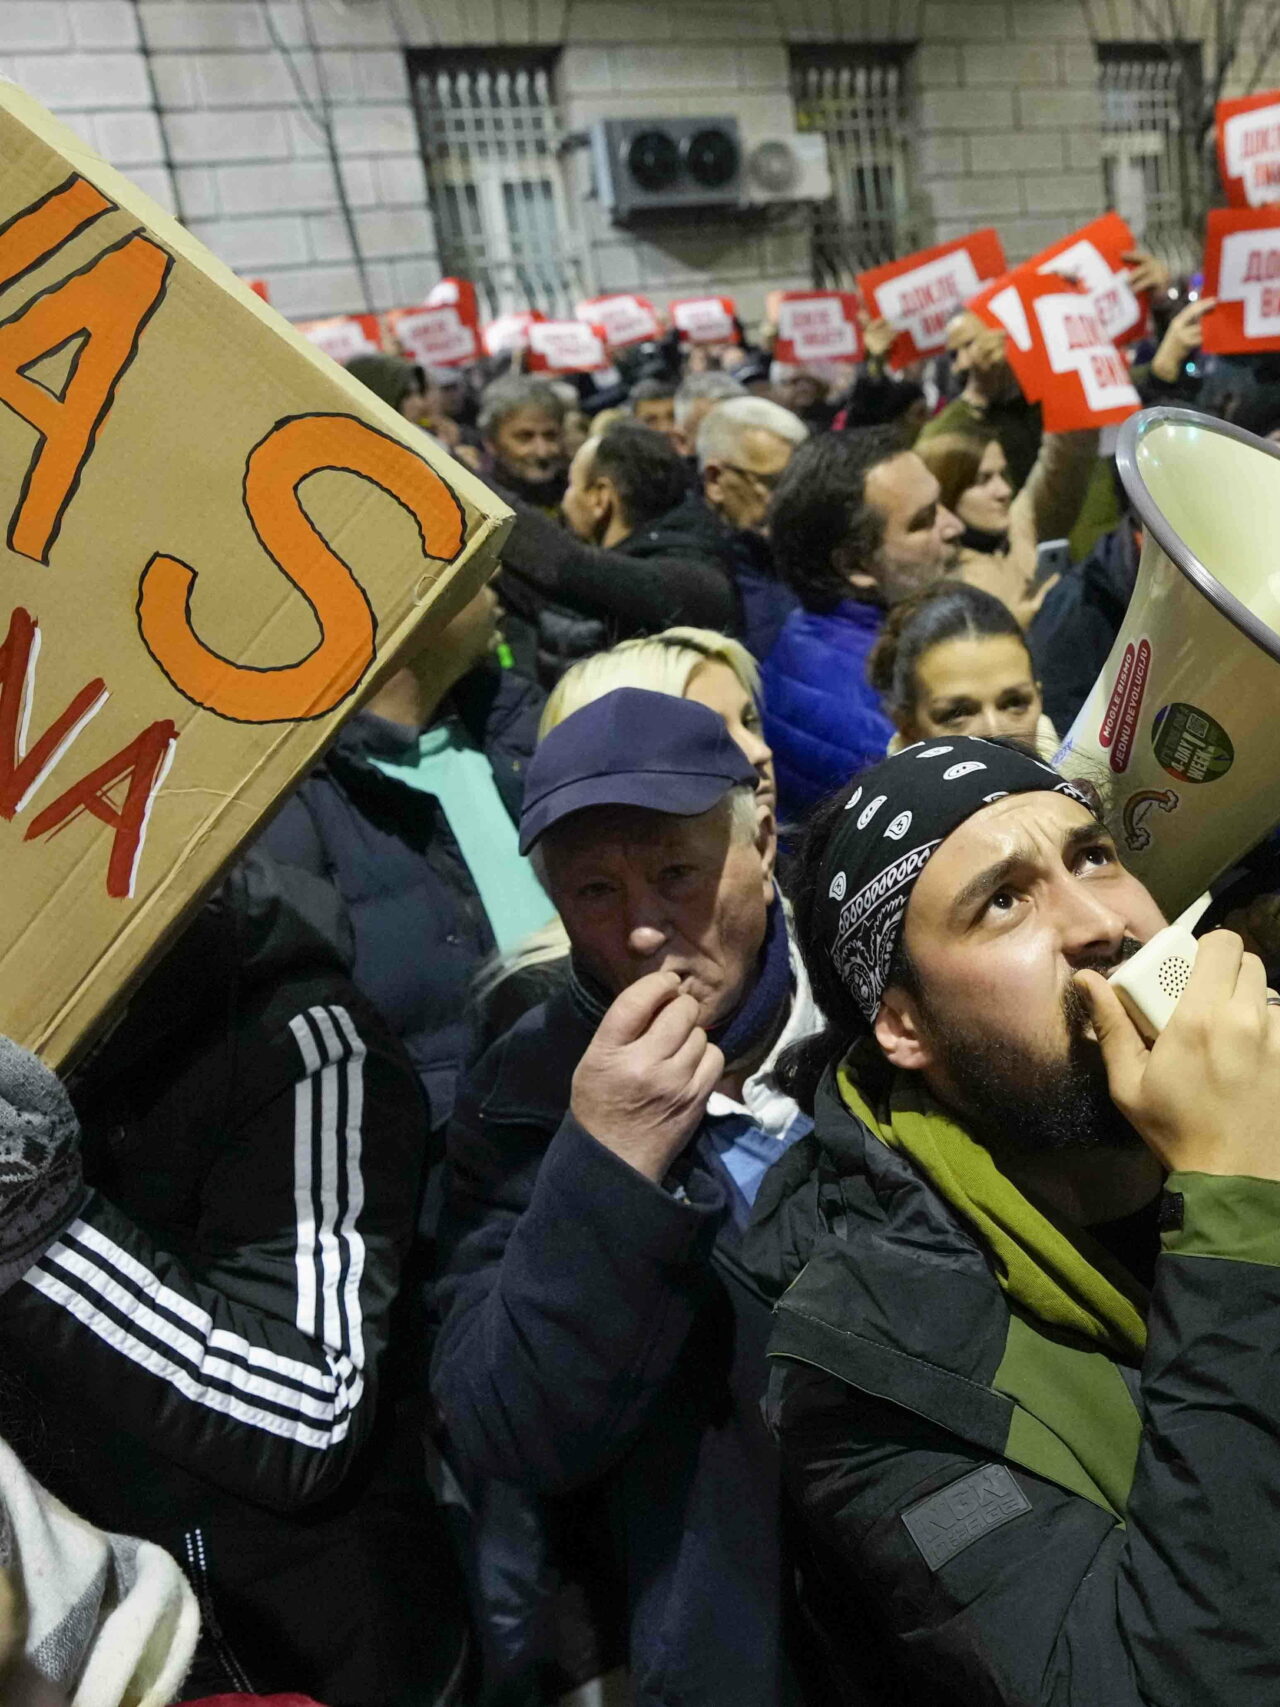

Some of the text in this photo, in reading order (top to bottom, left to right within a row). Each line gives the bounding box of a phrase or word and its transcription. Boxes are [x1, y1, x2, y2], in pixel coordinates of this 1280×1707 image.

[0, 172, 467, 724] AS
[1103, 654, 1131, 738] MOGLE BISMO
[1115, 647, 1148, 767] JEDNU REVOLUCIJU
[1171, 739, 1194, 772] 4-DAY
